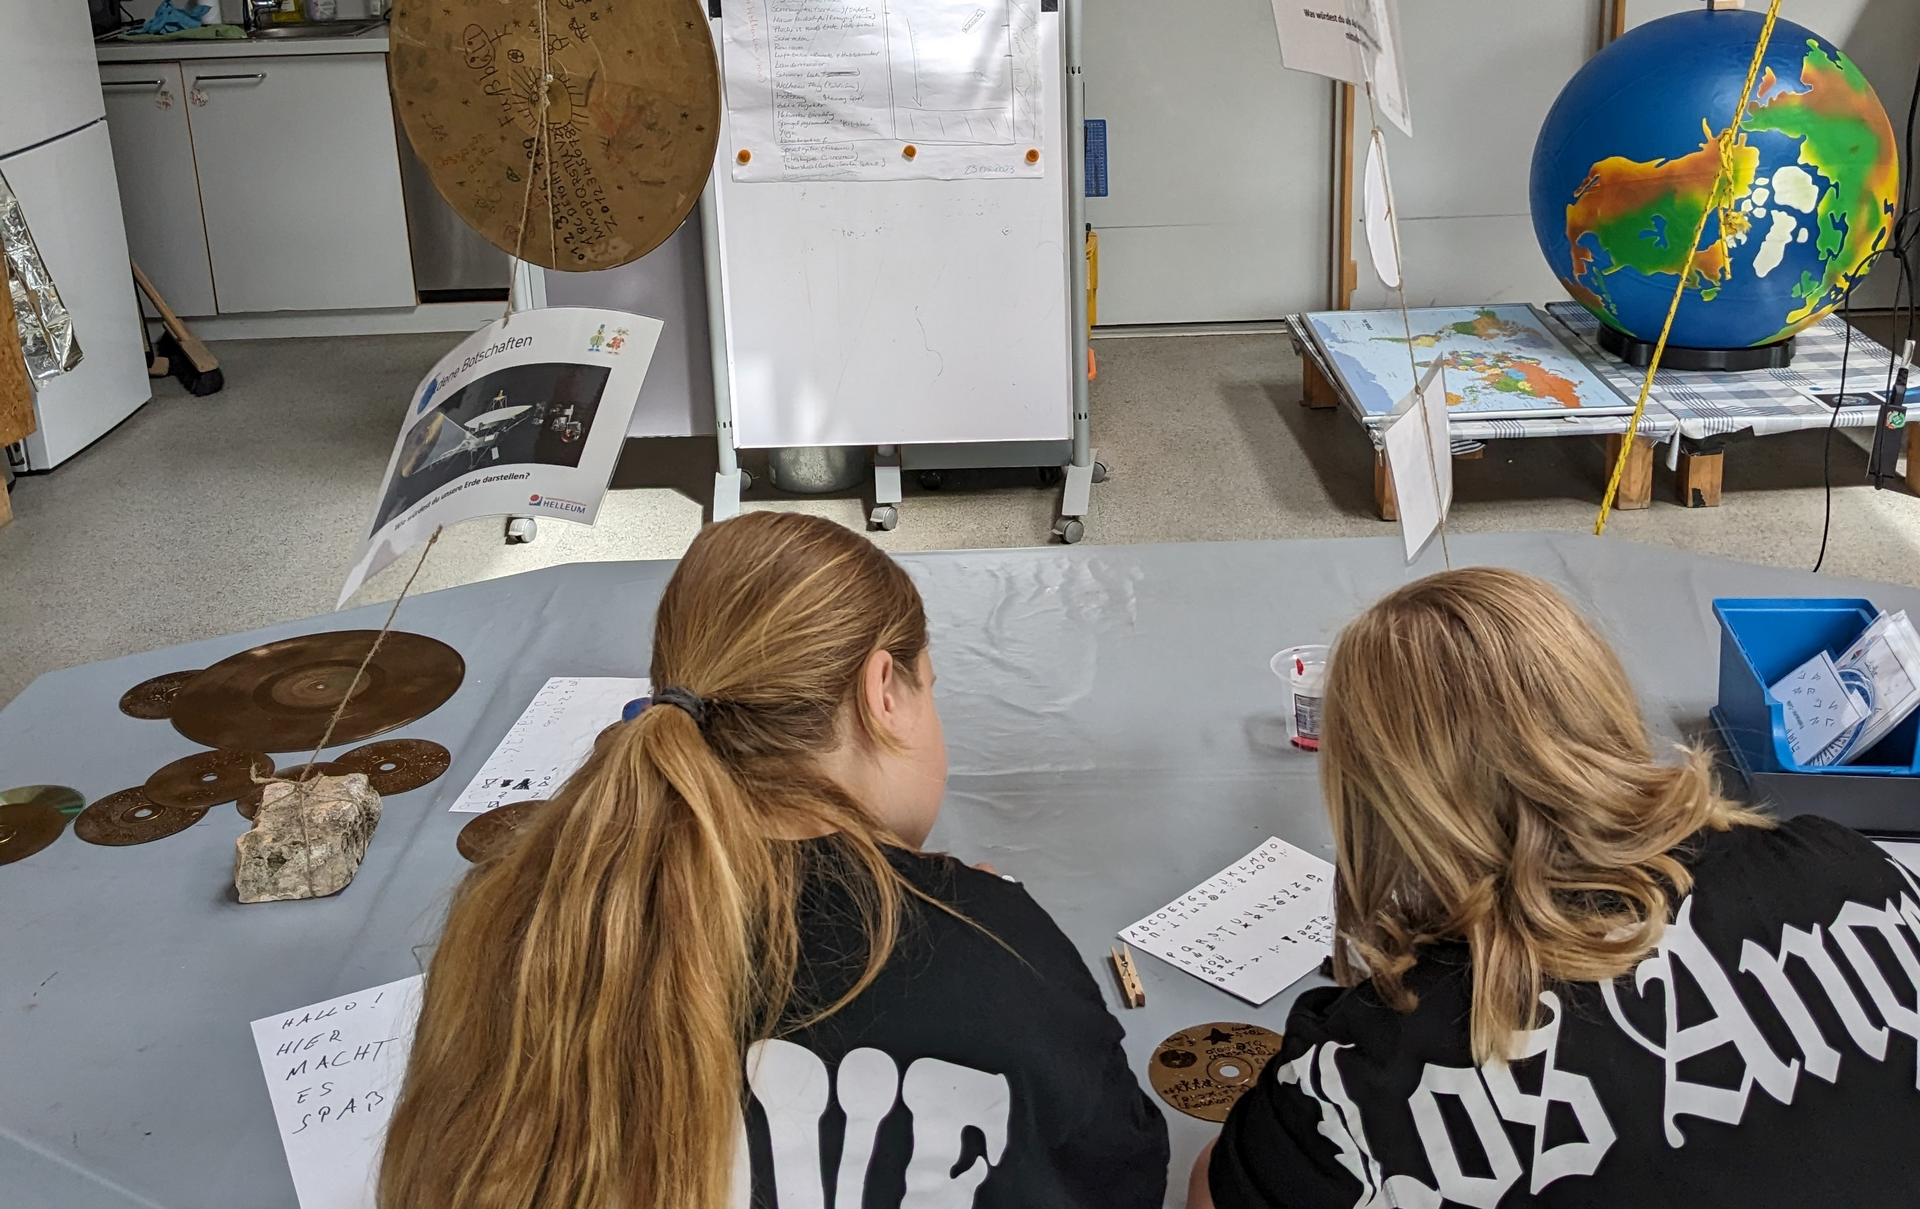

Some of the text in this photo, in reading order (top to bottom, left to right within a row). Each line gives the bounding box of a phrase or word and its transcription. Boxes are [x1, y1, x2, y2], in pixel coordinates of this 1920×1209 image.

[1303, 9, 1316, 19] Was
[1316, 11, 1338, 23] würdest
[1338, 15, 1345, 24] du
[461, 336, 533, 373] Botschaften
[431, 495, 440, 506] du
[440, 485, 463, 500] unsere
[464, 478, 482, 489] Erde
[482, 472, 531, 484] darstellen?
[543, 500, 586, 514] HELLEUM
[276, 1029, 343, 1056] HIER
[285, 1037, 399, 1081] MACHT
[296, 1082, 335, 1104] ES
